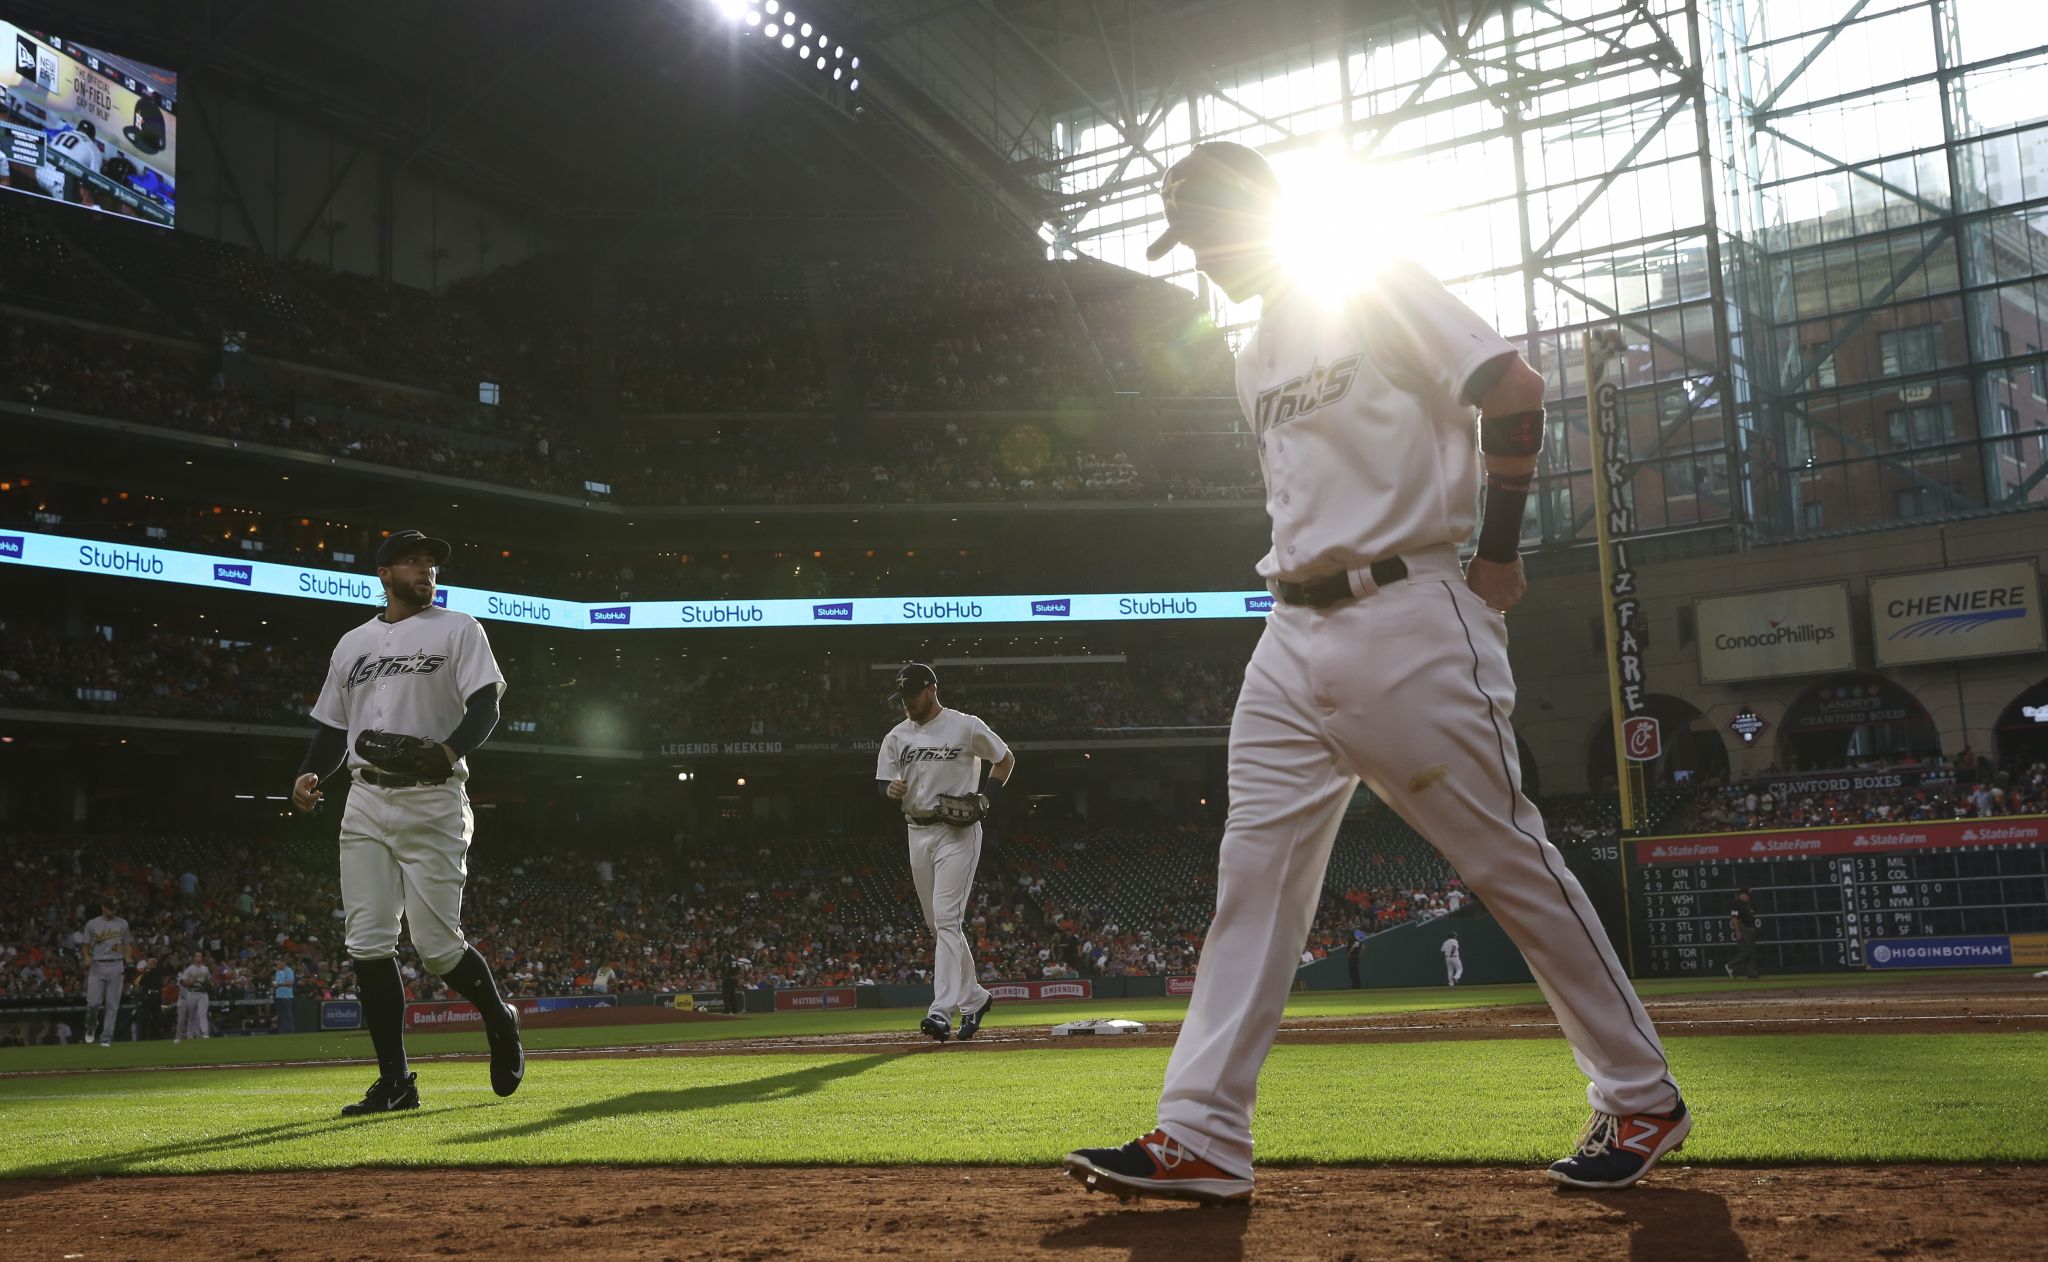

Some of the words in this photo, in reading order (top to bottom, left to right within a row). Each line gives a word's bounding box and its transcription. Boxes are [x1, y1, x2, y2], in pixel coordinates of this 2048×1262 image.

[87, 74, 110, 94] OFFICIAL
[74, 78, 111, 110] ON-FIELD
[56, 133, 79, 150] 10
[1600, 386, 1628, 533] CHIKIN
[79, 545, 163, 574] StubHub
[218, 568, 248, 579] StubHub
[1615, 544, 1633, 593] IZ
[299, 573, 371, 599] StubHub
[488, 597, 550, 620] StubHub
[903, 601, 982, 618] StubHub
[1120, 598, 1197, 615] StubHub
[1888, 586, 2024, 618] CHENIERE
[594, 612, 626, 620] StubHub
[682, 605, 763, 622] StubHub
[817, 608, 848, 616] StubHub
[1715, 624, 1834, 650] ConocoPhillips
[1617, 602, 1644, 711] FARE
[1820, 697, 1881, 712] LANDRY'S
[1801, 713, 1865, 726] CRAWFORD
[1869, 709, 1906, 720] BOXES
[661, 742, 719, 755] LEGENDS
[724, 742, 782, 754] WEEKEND
[1769, 778, 1850, 794] CRAWFORD
[1854, 775, 1902, 790] BOXES
[1591, 847, 1618, 860] 315
[1672, 869, 1688, 878] CIN
[1699, 868, 1706, 876] 0
[1712, 867, 1718, 876] 0
[1829, 861, 1835, 870] 0
[1887, 858, 1906, 867] MIL
[1673, 880, 1690, 890] ATL
[1701, 880, 1706, 888] 0
[1831, 873, 1836, 882] 0
[1888, 870, 1908, 879] COL
[1921, 884, 1928, 893] 0
[1935, 884, 1942, 893] 0
[1671, 896, 1693, 904] WSH
[1889, 897, 1914, 907] NYM
[1922, 897, 1929, 906] 0
[1677, 907, 1689, 916] SD
[1842, 864, 1859, 960] NATIONAL
[1895, 913, 1912, 922] PHI
[1677, 922, 1693, 931] STL
[1704, 921, 1710, 929] 0
[1718, 921, 1722, 929] 1
[1755, 919, 1761, 928] 0
[1836, 916, 1840, 924] 1
[1899, 925, 1910, 935] SF
[1925, 925, 1933, 934] N
[1678, 934, 1693, 942] PIT
[1706, 933, 1712, 942] 0
[1718, 933, 1724, 941] 5
[1836, 928, 1842, 937] 5
[1678, 948, 1696, 957] TOR
[1838, 943, 1844, 952] 3
[1892, 945, 2003, 958] HIGGINBOTHAM
[1680, 960, 1696, 969] CHI
[1838, 956, 1845, 965] 4
[1044, 985, 1080, 994] SMIRNOFF
[664, 1000, 674, 1008] the
[694, 998, 724, 1008] generation
[414, 1012, 436, 1024] Bank
[438, 1011, 447, 1022] of
[447, 1010, 481, 1022] America
